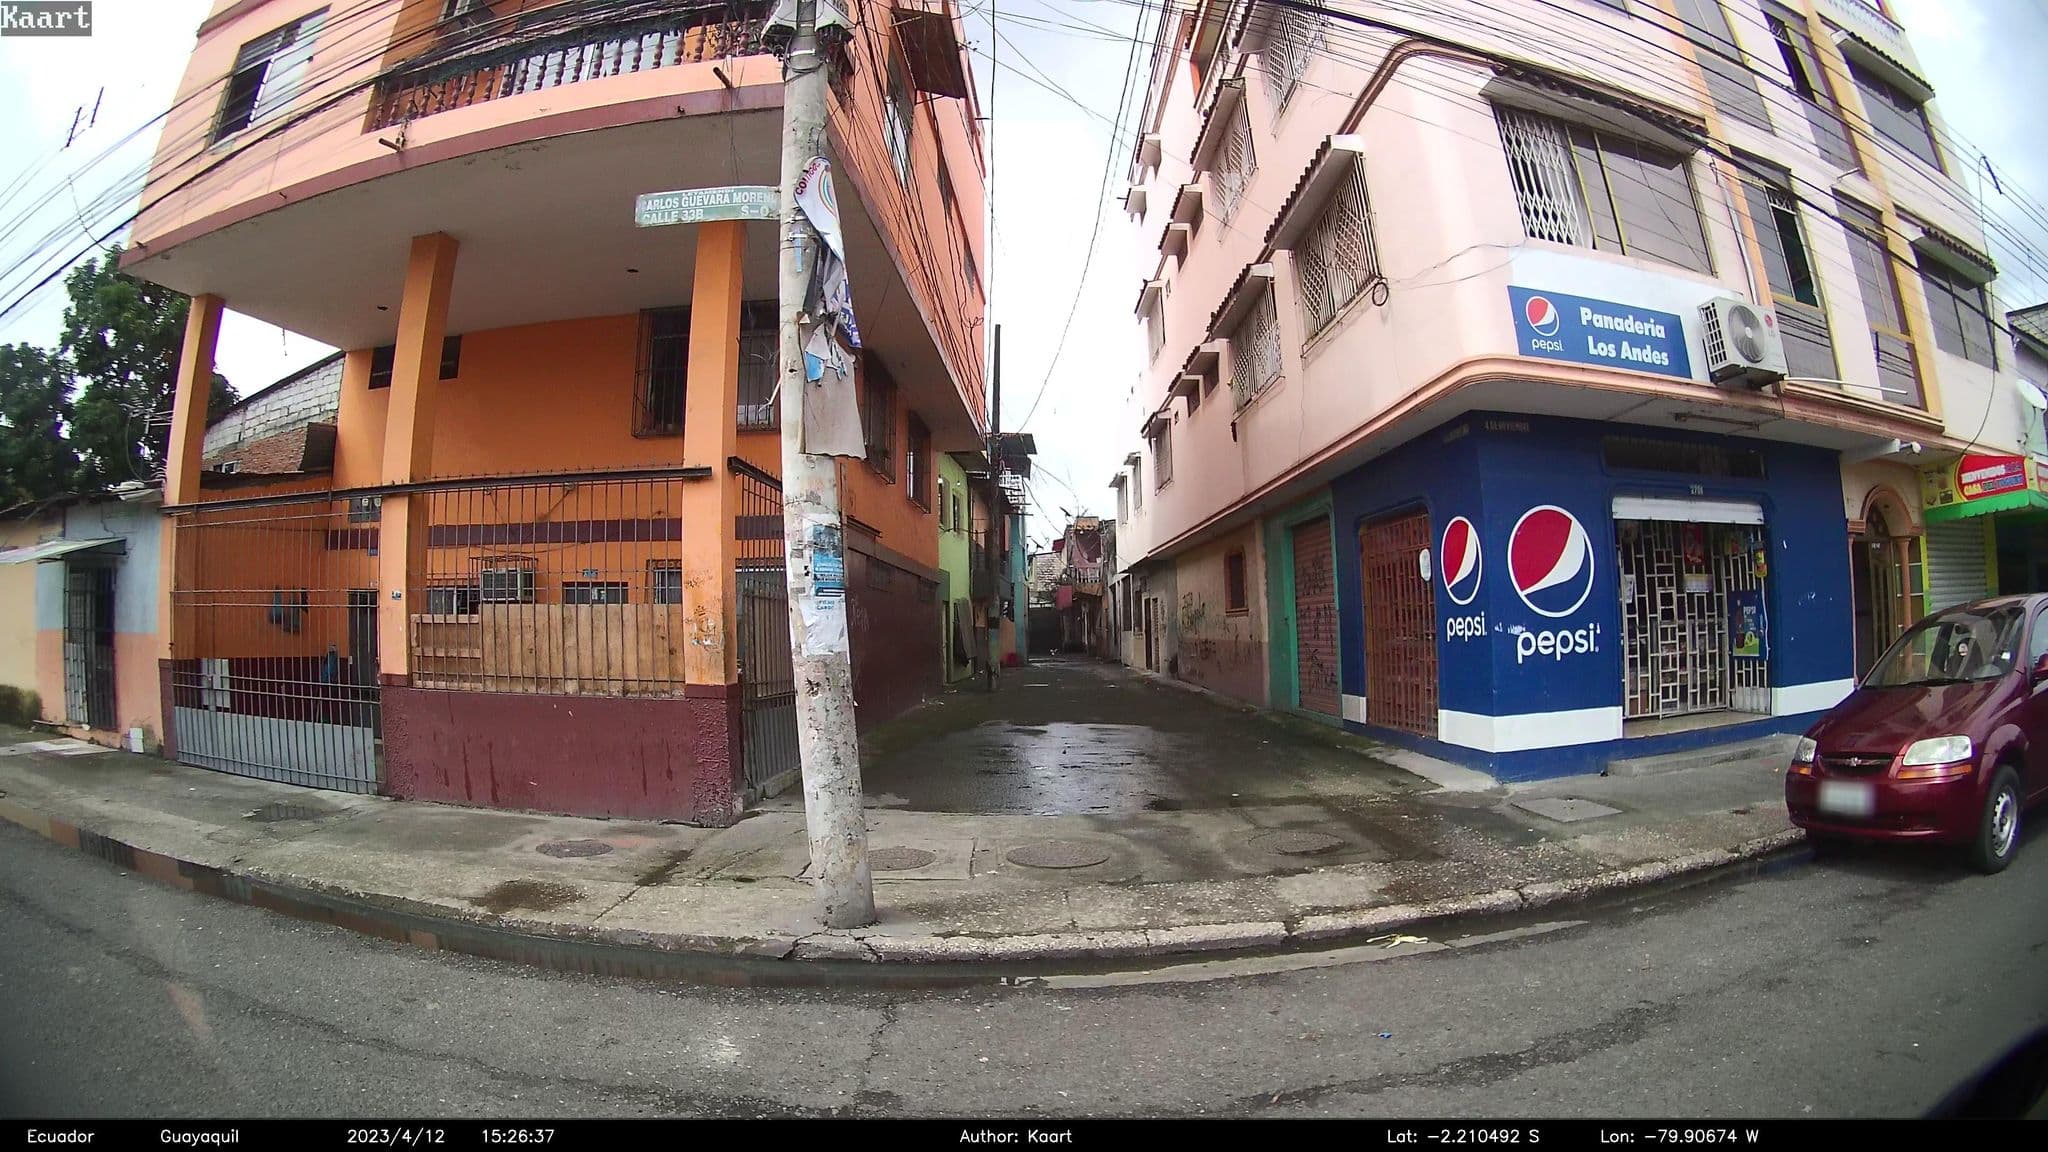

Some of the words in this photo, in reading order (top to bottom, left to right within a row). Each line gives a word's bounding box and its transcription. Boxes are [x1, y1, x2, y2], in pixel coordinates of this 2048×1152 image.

[681, 192, 730, 208] GUEVARA
[642, 210, 680, 225] CALLE
[681, 208, 704, 221] 33B
[1579, 306, 1666, 339] Panaderia
[1531, 338, 1563, 353] pepsi
[1587, 335, 1617, 356] Los
[1620, 340, 1670, 366] Andes
[1446, 610, 1486, 642] pepsi
[1516, 622, 1596, 664] pepsi
